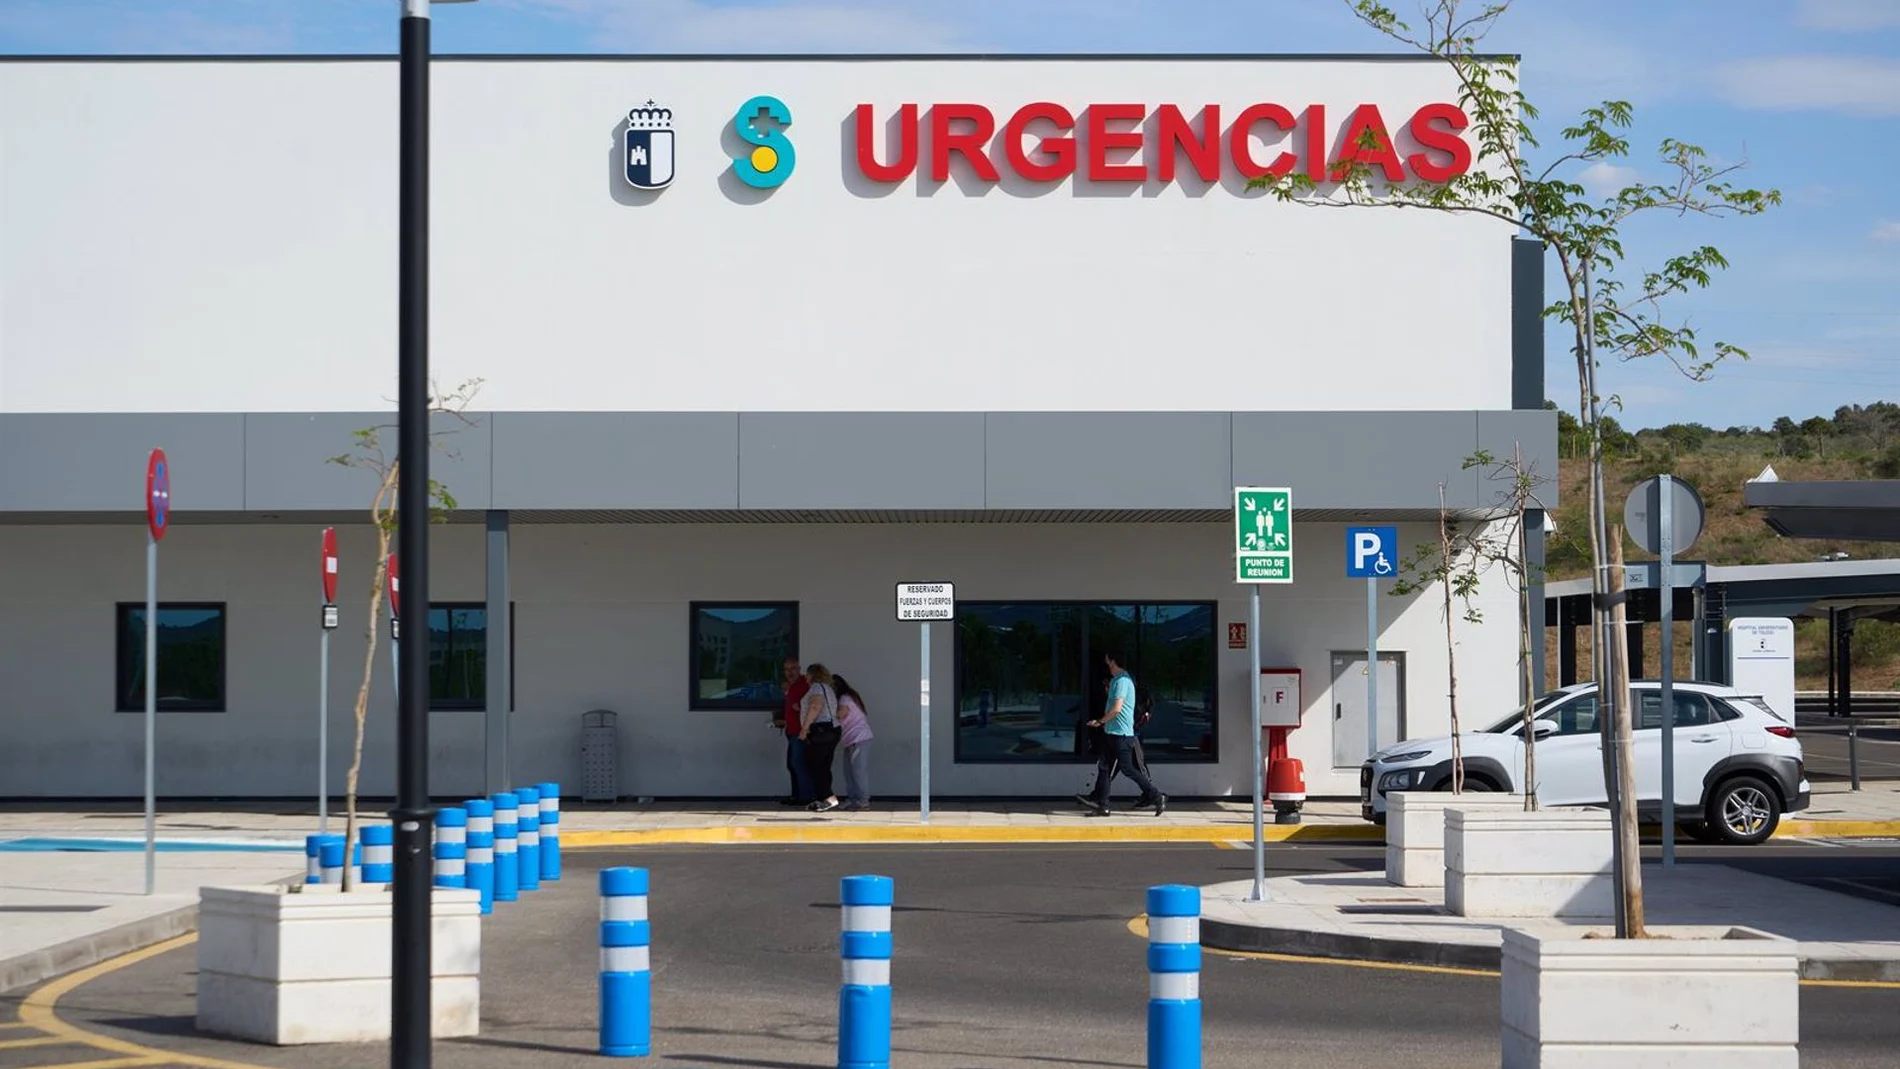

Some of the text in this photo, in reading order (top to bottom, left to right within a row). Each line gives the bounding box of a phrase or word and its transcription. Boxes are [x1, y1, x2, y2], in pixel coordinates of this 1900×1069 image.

[856, 101, 1471, 182] URGENCIAS
[1354, 532, 1381, 569] P
[1245, 559, 1285, 567] PUNTO DE
[1247, 568, 1283, 577] REUNION
[907, 585, 944, 593] RESERVADO
[900, 597, 952, 605] FUERZAS Y CUERPOS
[903, 610, 949, 618] DE SEGURIDAD
[1275, 691, 1284, 704] F
